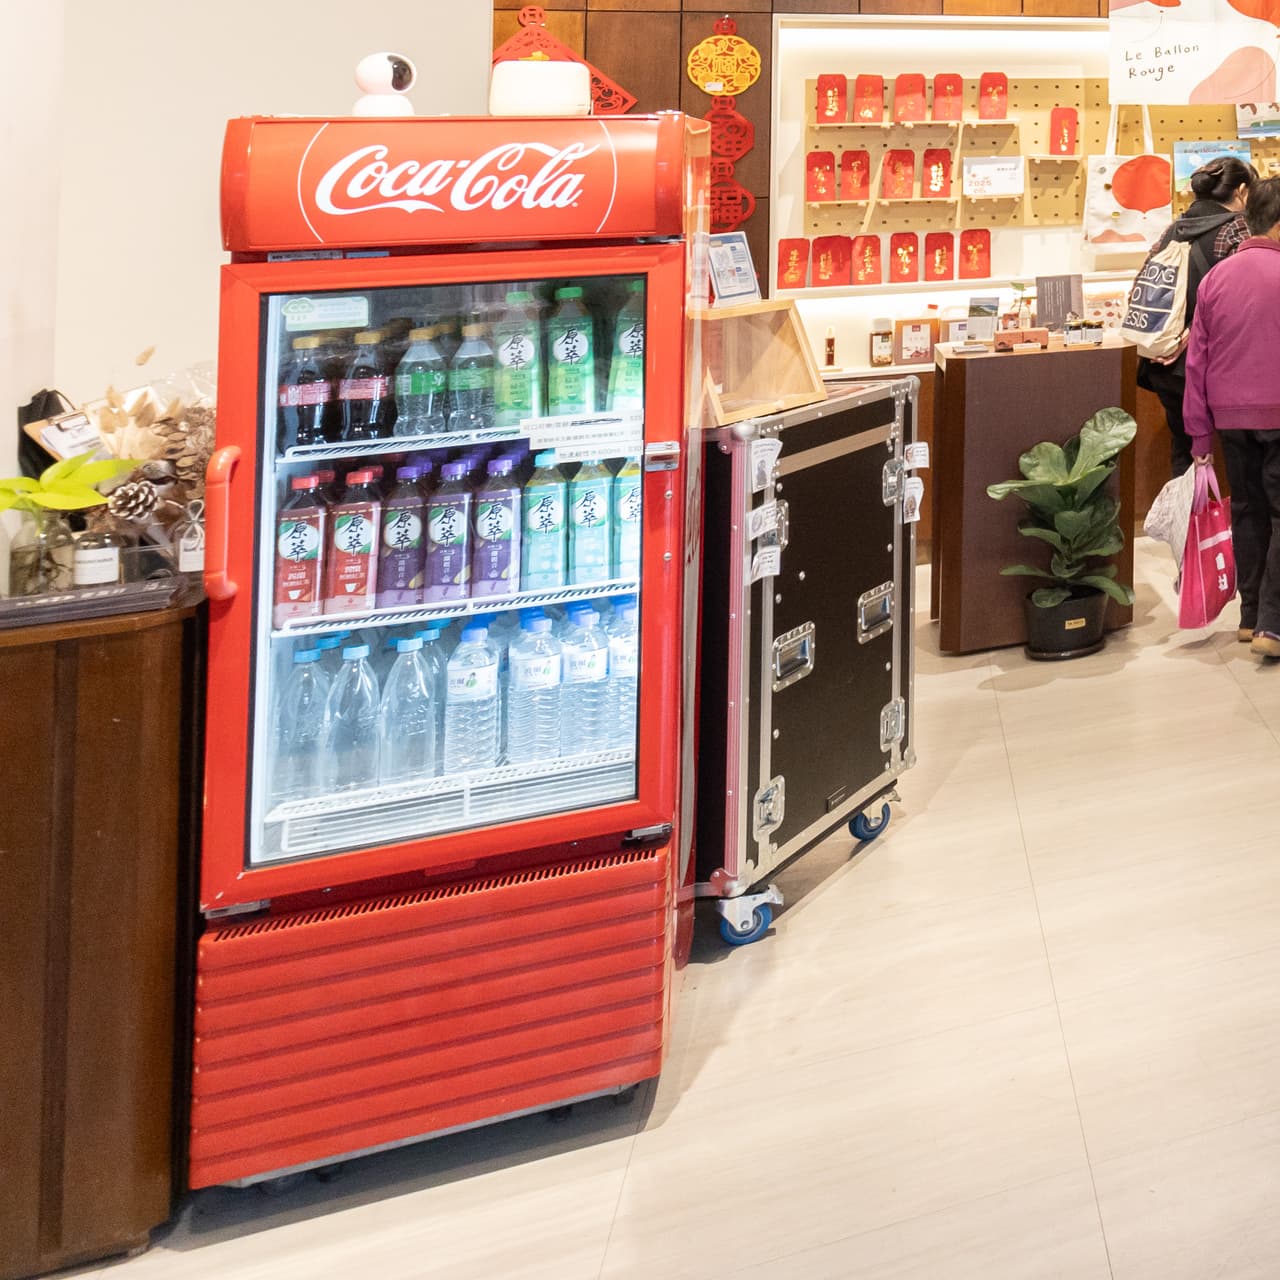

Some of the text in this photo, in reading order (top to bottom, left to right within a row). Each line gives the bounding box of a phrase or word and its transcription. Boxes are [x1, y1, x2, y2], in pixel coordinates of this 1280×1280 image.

[1125, 43, 1200, 62] Le Ballon
[1128, 64, 1176, 82] Rouge
[315, 142, 600, 215] Coca-Cola
[503, 333, 526, 371] 原萃
[557, 327, 582, 365] 原萃
[438, 506, 458, 548] 原萃
[482, 502, 504, 543] 原萃
[532, 495, 556, 535] 原萃
[576, 489, 599, 529] 原萃
[287, 521, 309, 562] 原萃
[342, 514, 365, 556] 原萃
[391, 510, 412, 551] 原萃
